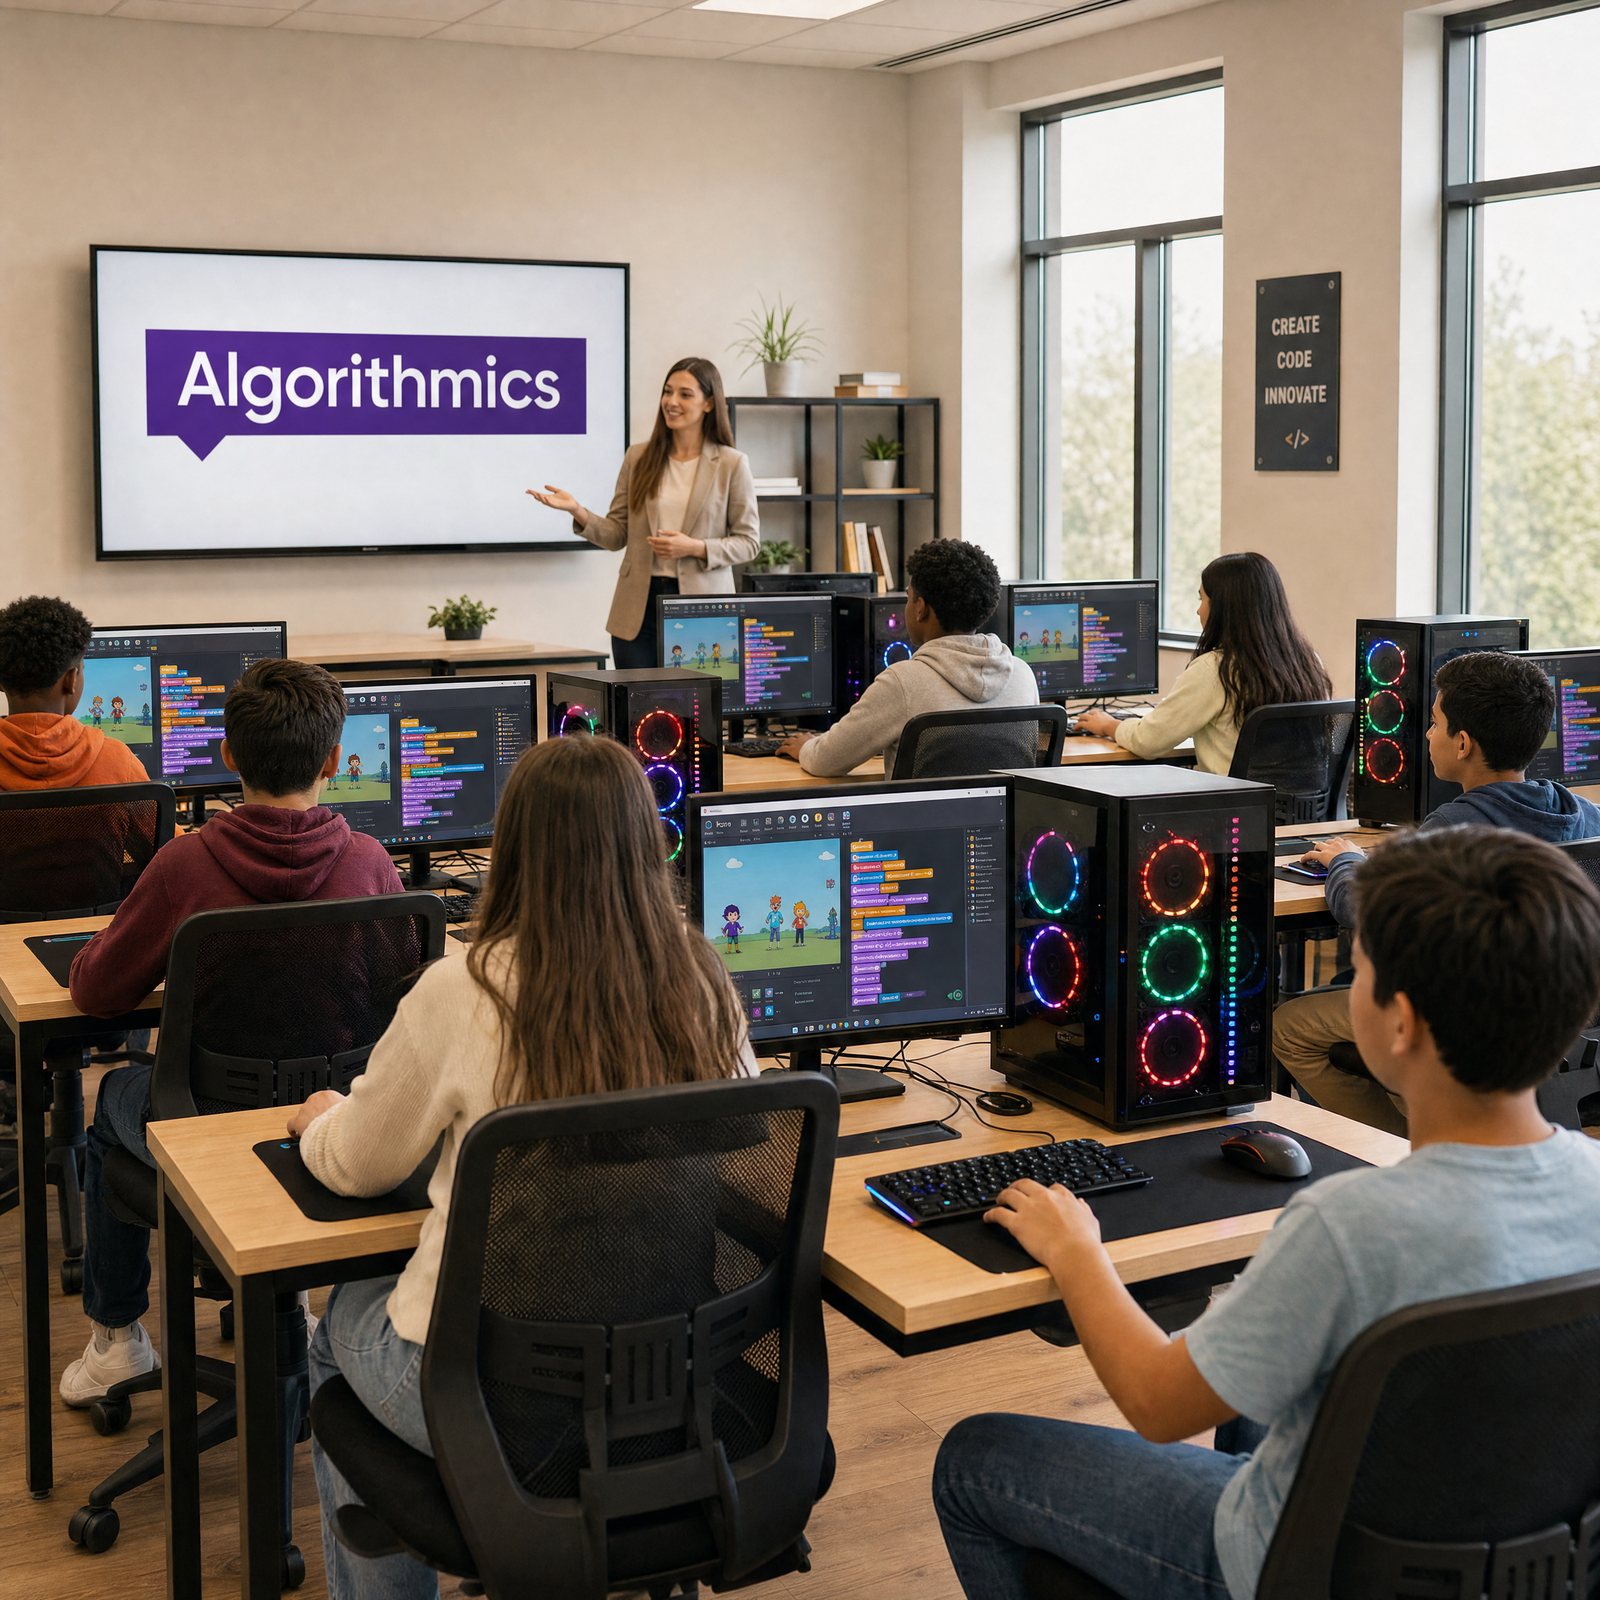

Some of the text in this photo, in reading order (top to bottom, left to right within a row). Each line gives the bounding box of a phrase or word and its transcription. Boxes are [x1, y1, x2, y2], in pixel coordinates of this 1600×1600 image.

[1271, 315, 1320, 336] CREATE
[1276, 350, 1312, 370] CODE
[177, 351, 561, 424] Algorithmics
[1264, 385, 1327, 405] INNOVATE
